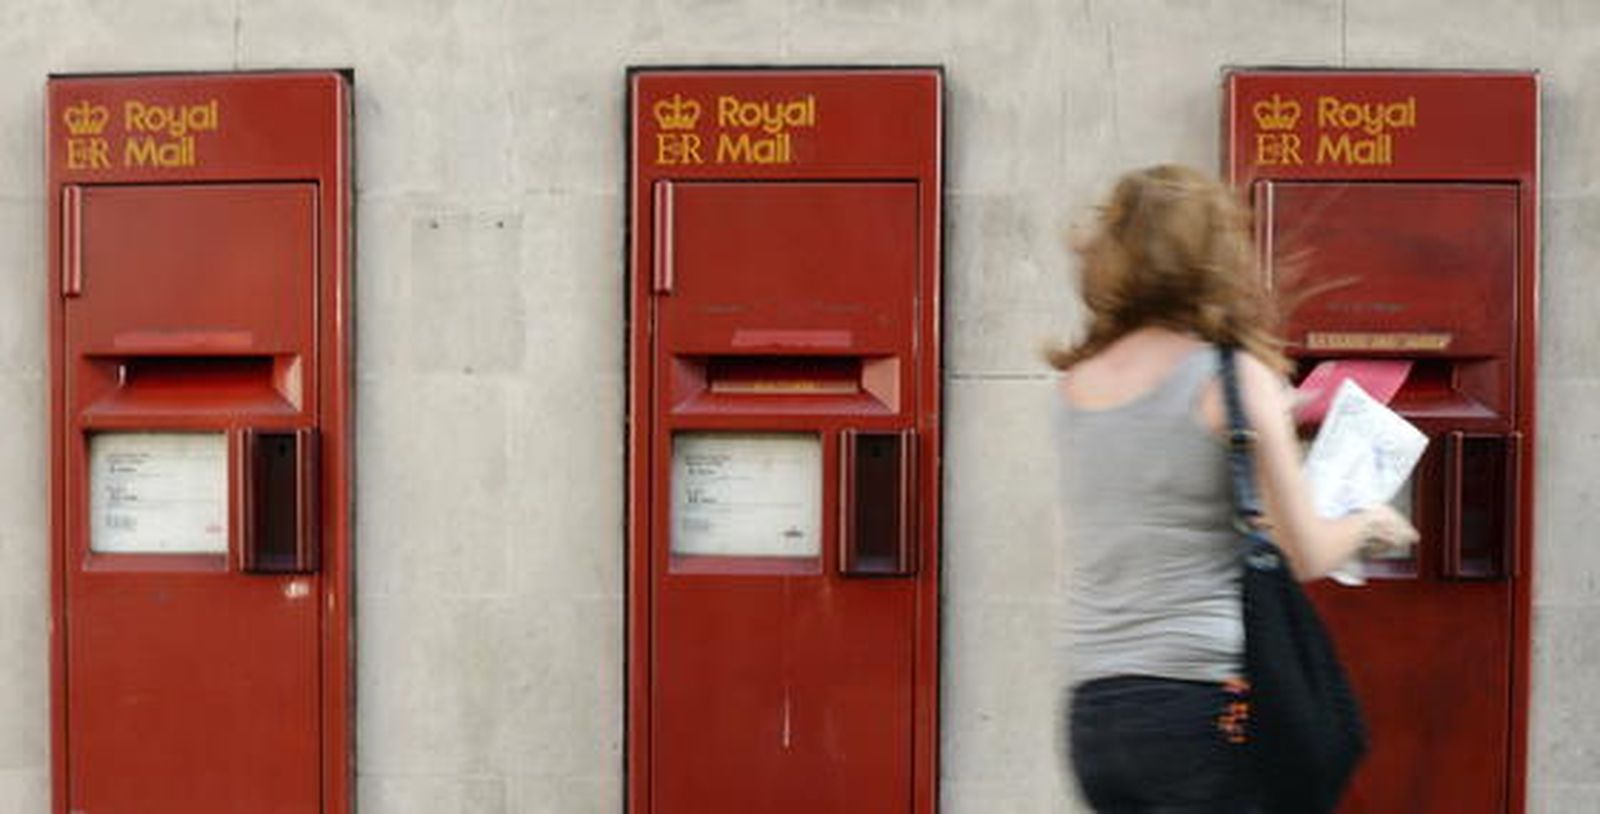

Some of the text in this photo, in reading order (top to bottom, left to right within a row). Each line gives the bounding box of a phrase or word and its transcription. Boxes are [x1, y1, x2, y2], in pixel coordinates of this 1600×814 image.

[124, 99, 218, 138] Royal
[718, 95, 816, 133] Royal
[1317, 96, 1416, 134] Royal
[124, 136, 195, 167] Mail
[716, 133, 791, 163] Mail
[1315, 133, 1392, 164] Mail
